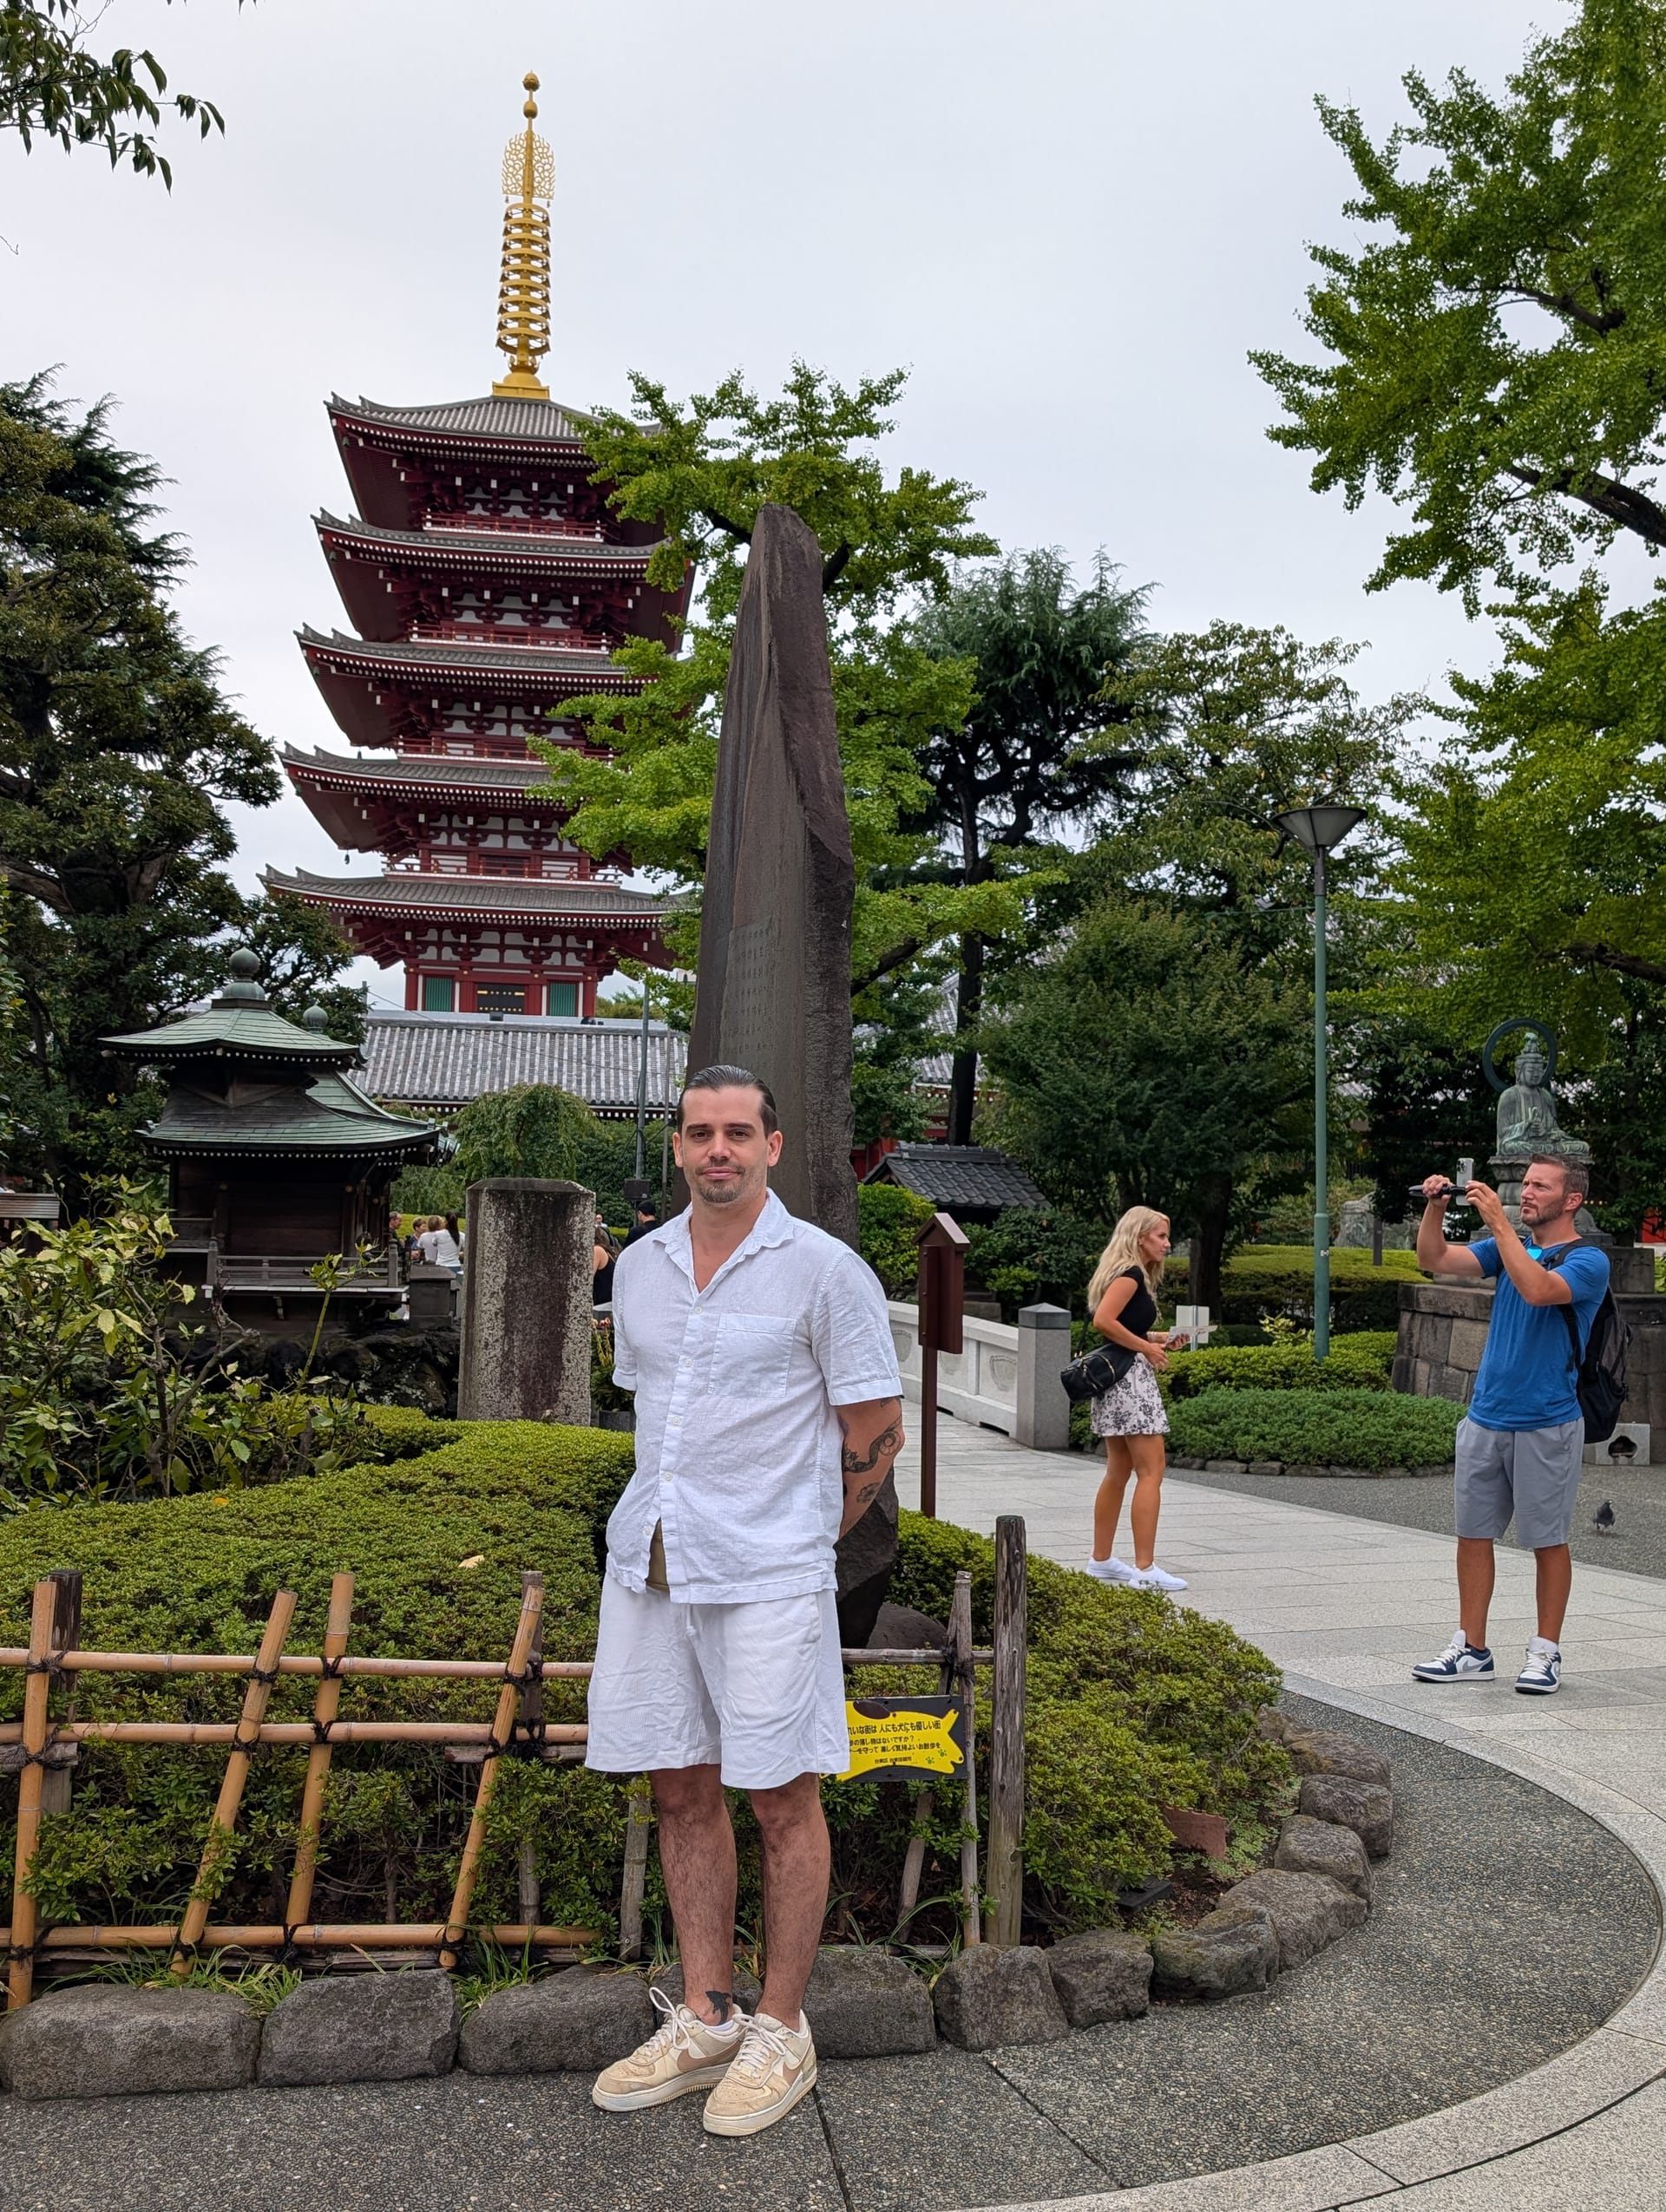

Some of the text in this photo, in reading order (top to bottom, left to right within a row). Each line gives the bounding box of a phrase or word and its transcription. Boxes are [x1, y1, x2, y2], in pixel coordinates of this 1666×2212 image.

[879, 1720, 941, 1733] 人にも犬にも優しい街
[849, 1746, 878, 1755] ーを守って
